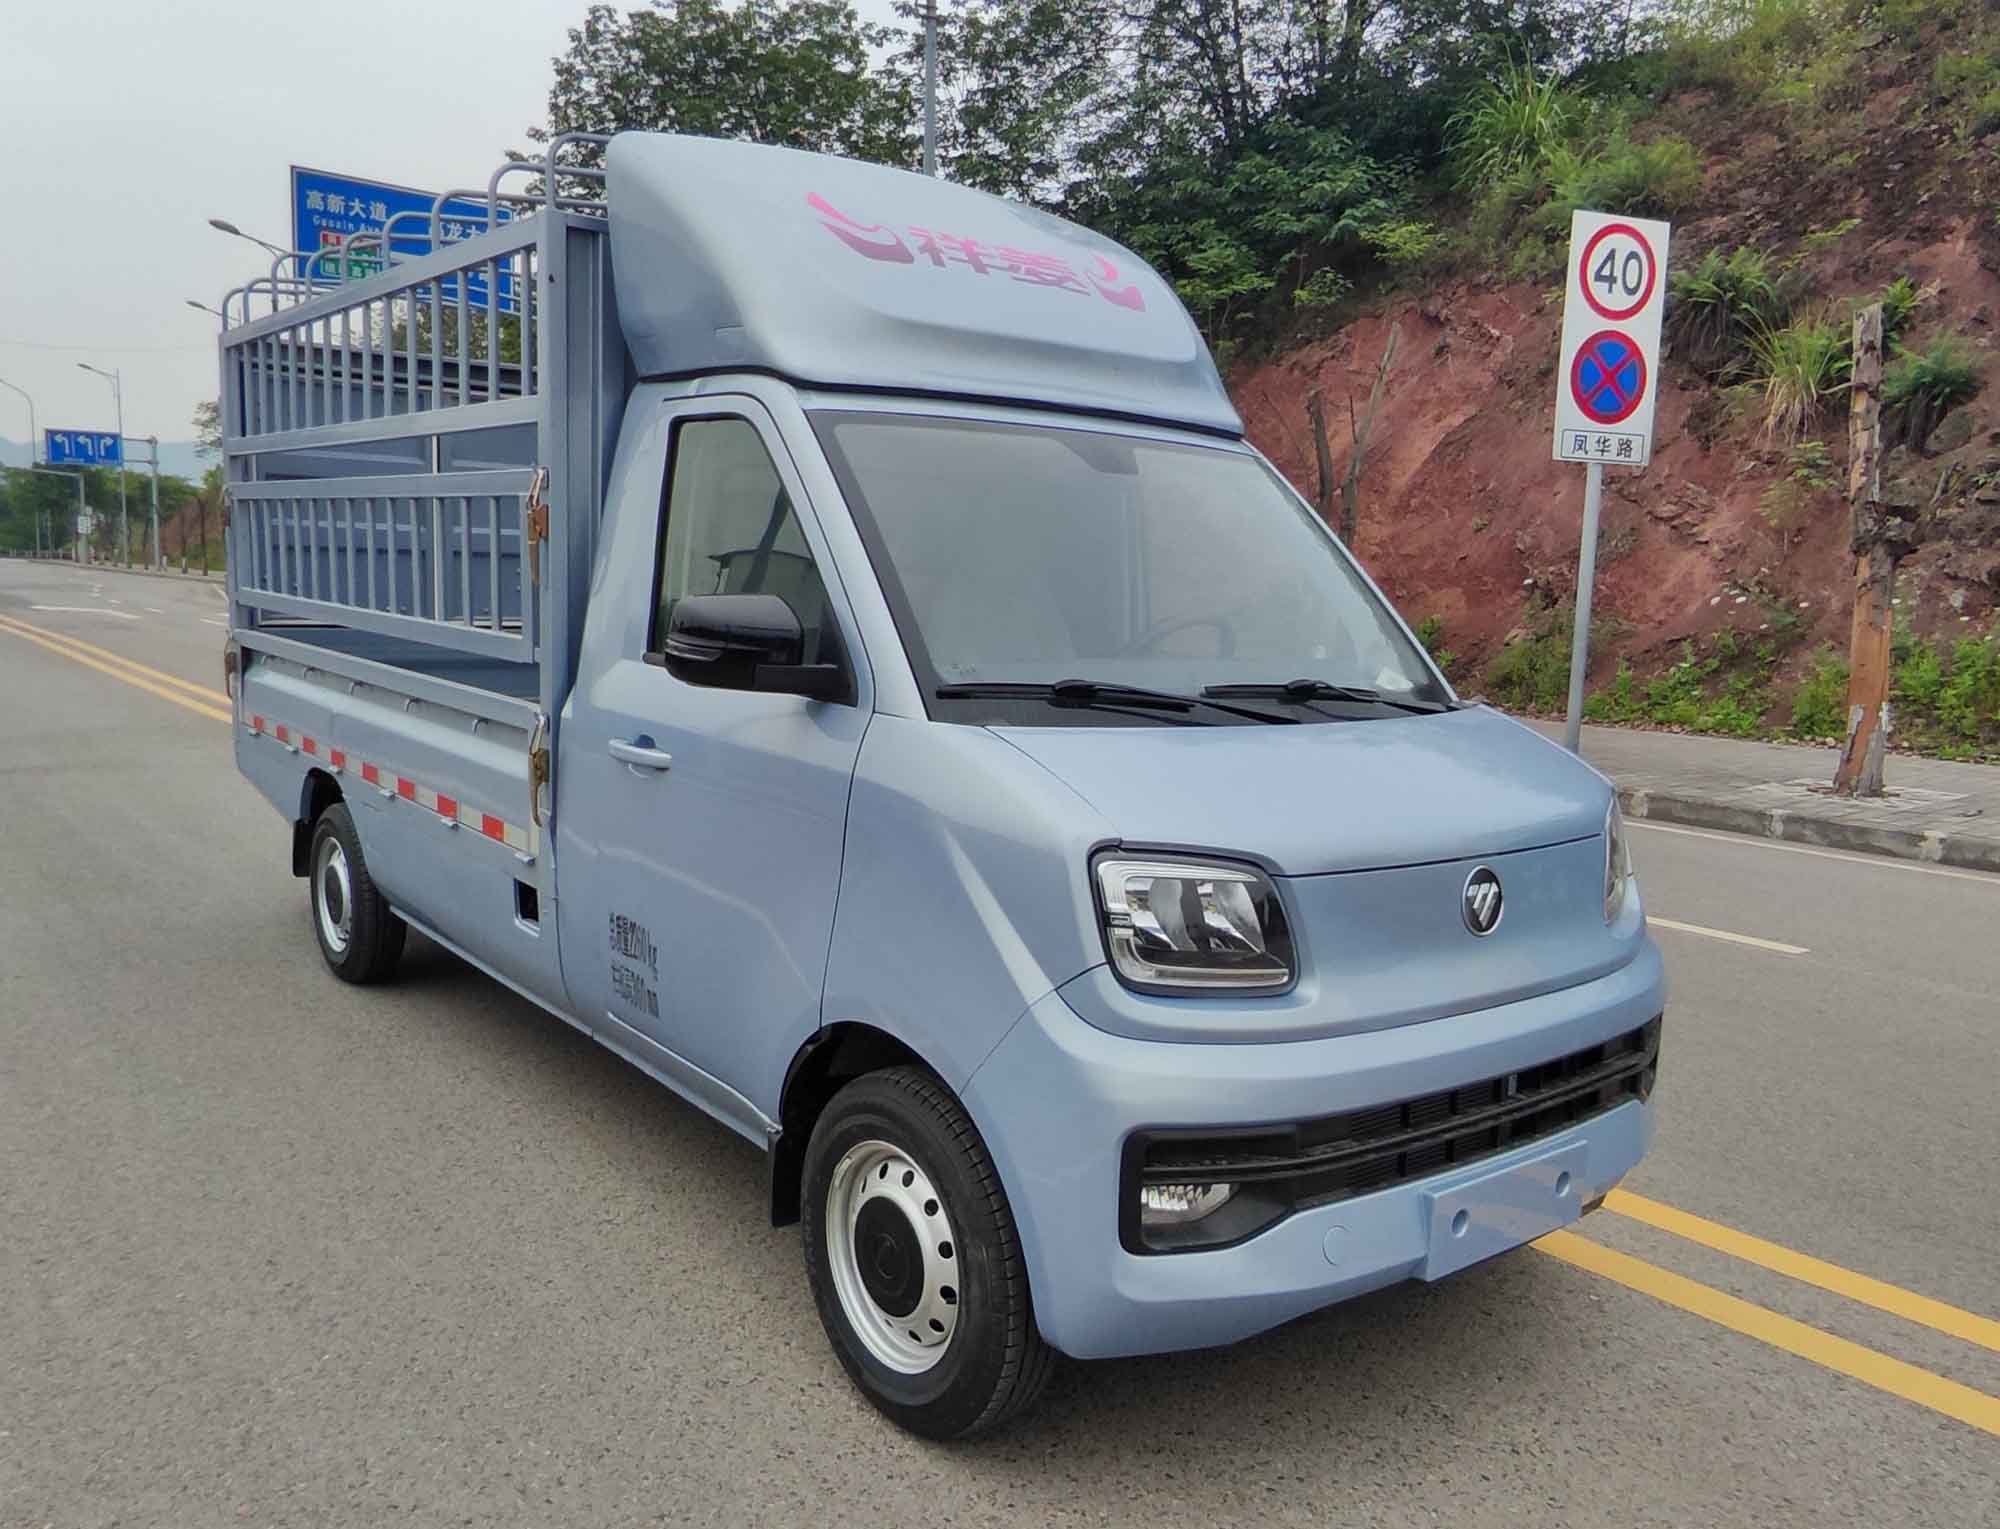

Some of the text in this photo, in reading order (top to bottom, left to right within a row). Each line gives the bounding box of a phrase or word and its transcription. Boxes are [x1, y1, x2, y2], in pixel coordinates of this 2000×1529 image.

[306, 190, 387, 222] 高新大道
[1593, 248, 1643, 296] 40
[1571, 434, 1634, 458] 凤华路
